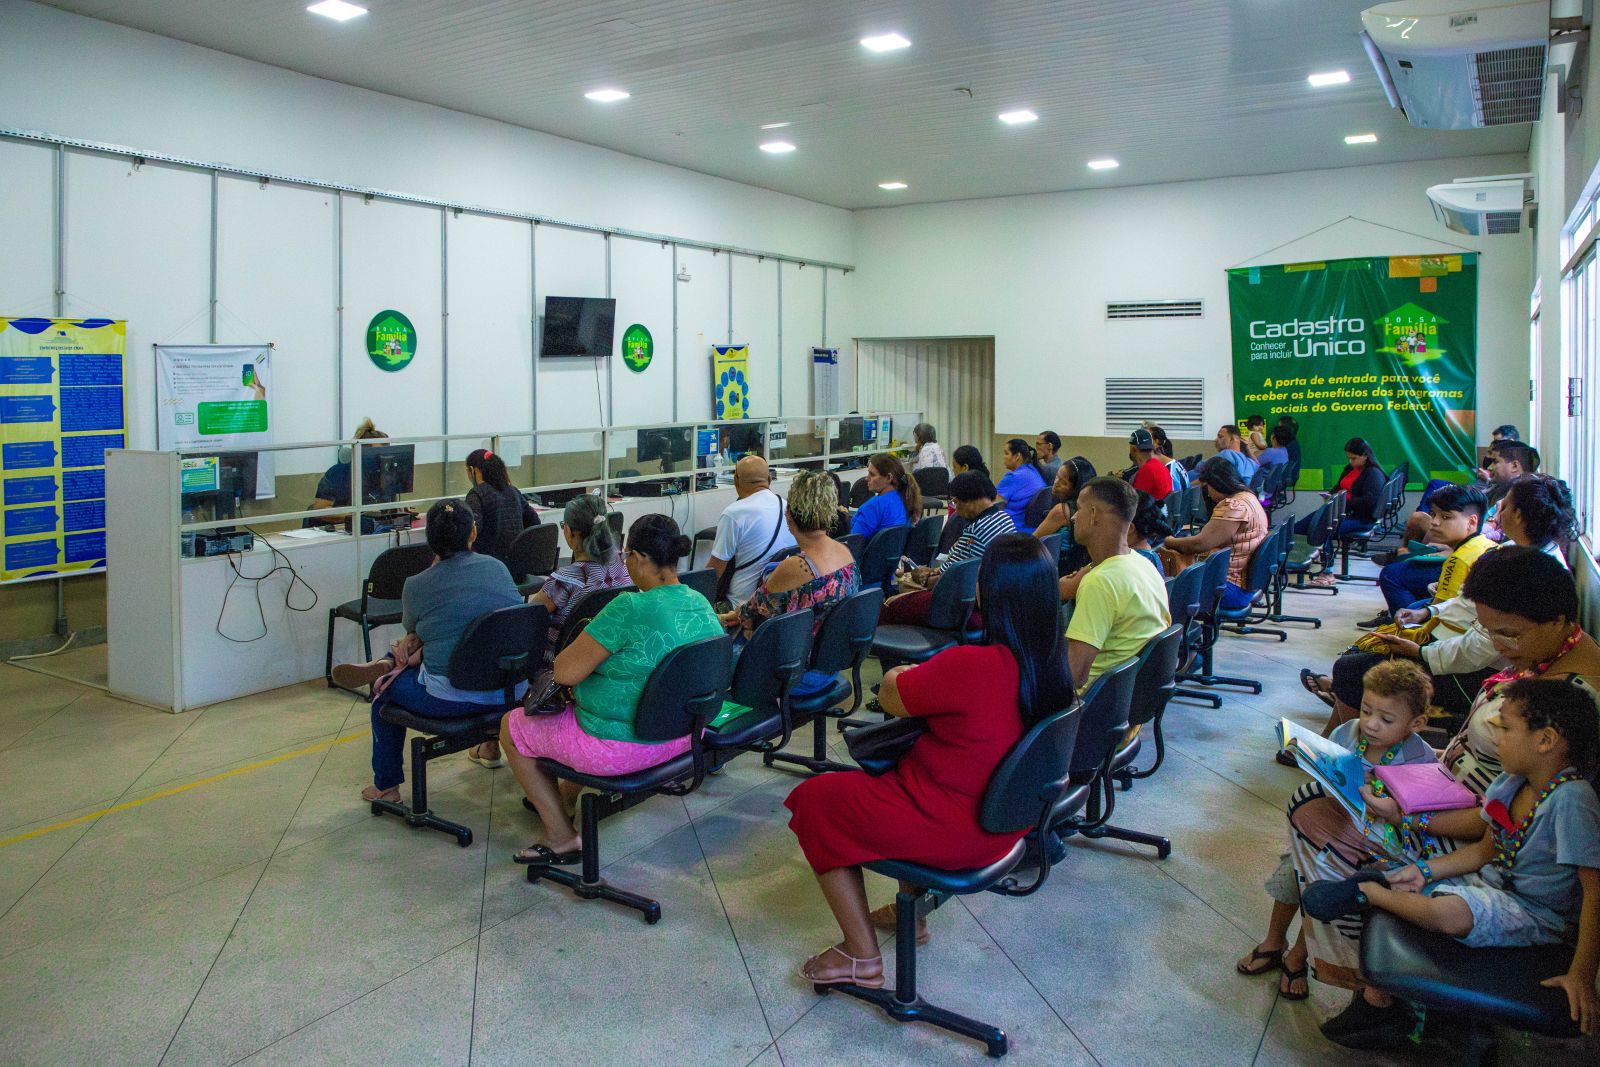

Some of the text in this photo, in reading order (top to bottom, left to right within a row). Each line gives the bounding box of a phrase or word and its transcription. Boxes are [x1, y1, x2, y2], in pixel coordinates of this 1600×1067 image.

[1249, 315, 1365, 339] Cadastro
[1385, 322, 1437, 336] Família
[1250, 341, 1287, 351] Conhecer
[1293, 337, 1366, 358] Único
[1250, 350, 1293, 361] para incluir
[1263, 373, 1441, 389] A porta de entrada para você
[1244, 390, 1288, 402] receber
[1291, 391, 1304, 400] os
[1371, 387, 1394, 397] dos
[1396, 388, 1464, 399] programas
[1270, 400, 1434, 414] sociais do Governo Federal.
